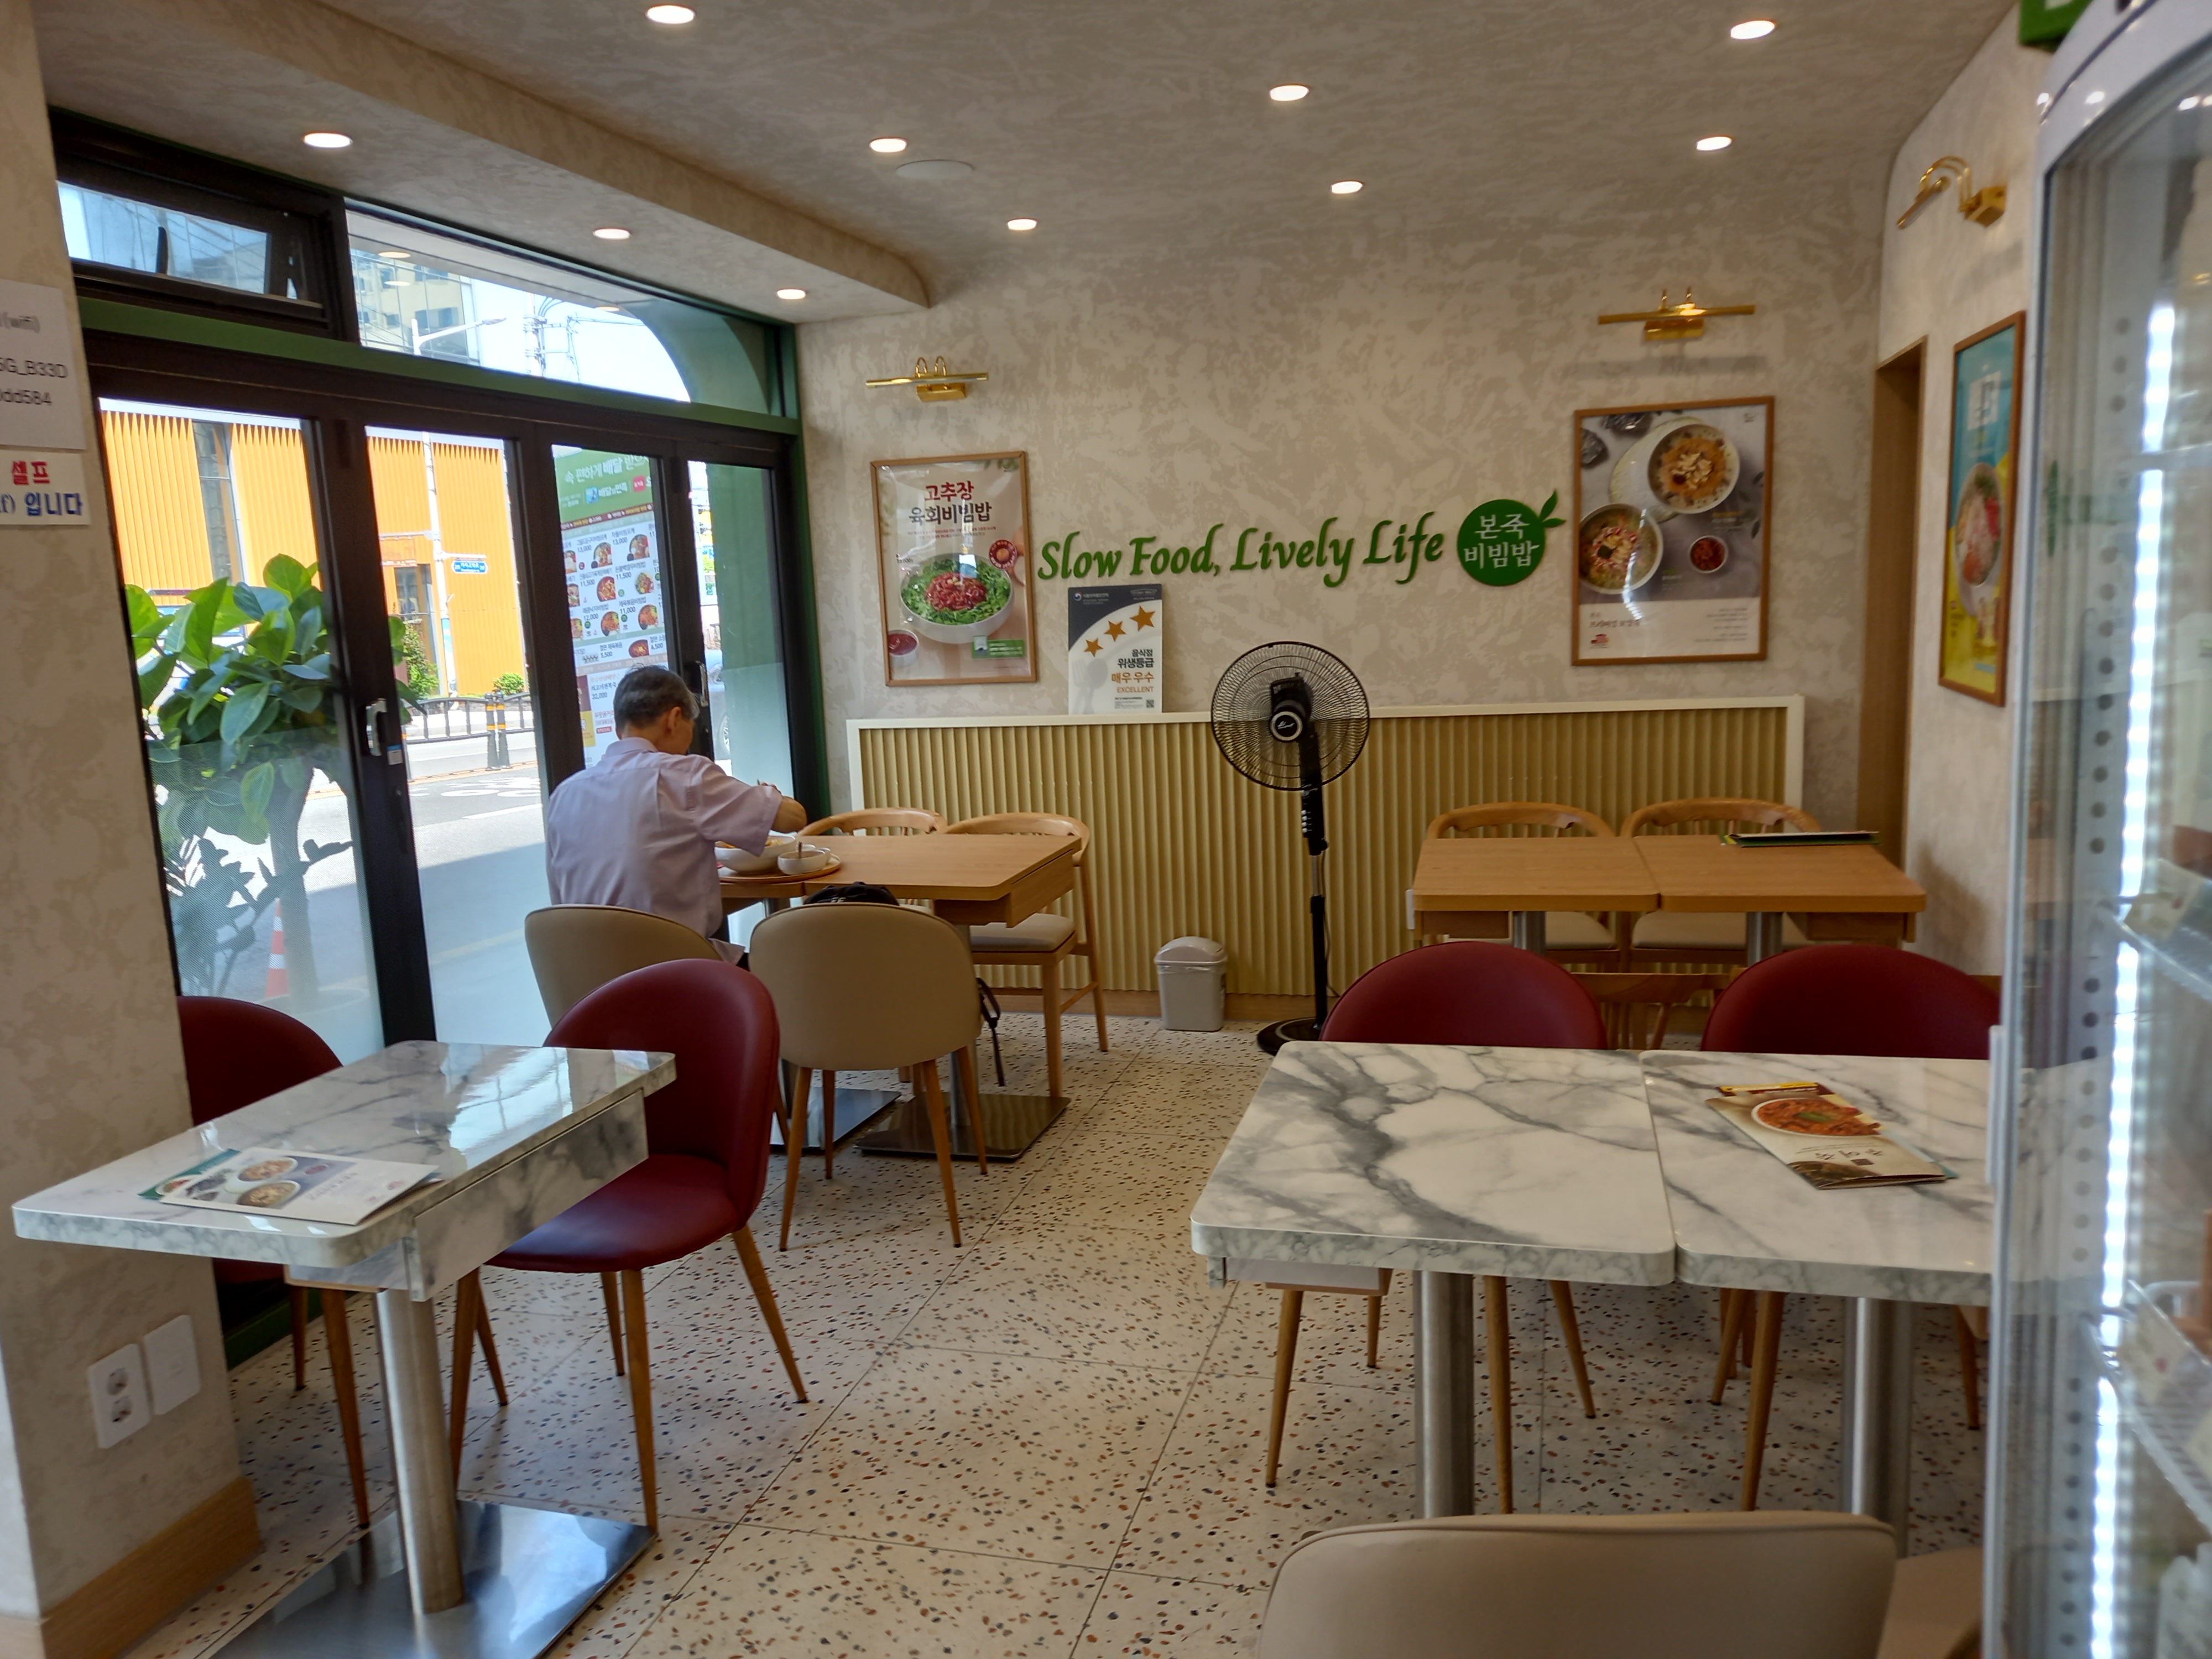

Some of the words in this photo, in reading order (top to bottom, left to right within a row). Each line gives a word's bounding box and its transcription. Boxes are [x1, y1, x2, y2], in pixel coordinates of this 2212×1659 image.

[602, 456, 623, 474] 배달
[924, 480, 974, 502] 고추장
[24, 492, 83, 517] 입니다
[909, 501, 992, 526] 육회비빔밥
[1474, 513, 1531, 540] 본죽
[577, 545, 592, 553] 13,000
[612, 537, 628, 545] 13,000
[1037, 531, 1122, 580] Slow
[1129, 523, 1224, 577] Food,
[1229, 517, 1355, 588] Lively
[1363, 511, 1444, 585] Life
[1463, 540, 1541, 570] 비빔밥
[583, 613, 599, 622] 12,000
[619, 606, 636, 614] 11,000
[1117, 658, 1155, 669] 위생등급
[1111, 672, 1132, 684] 매우
[1133, 671, 1155, 684] 우수
